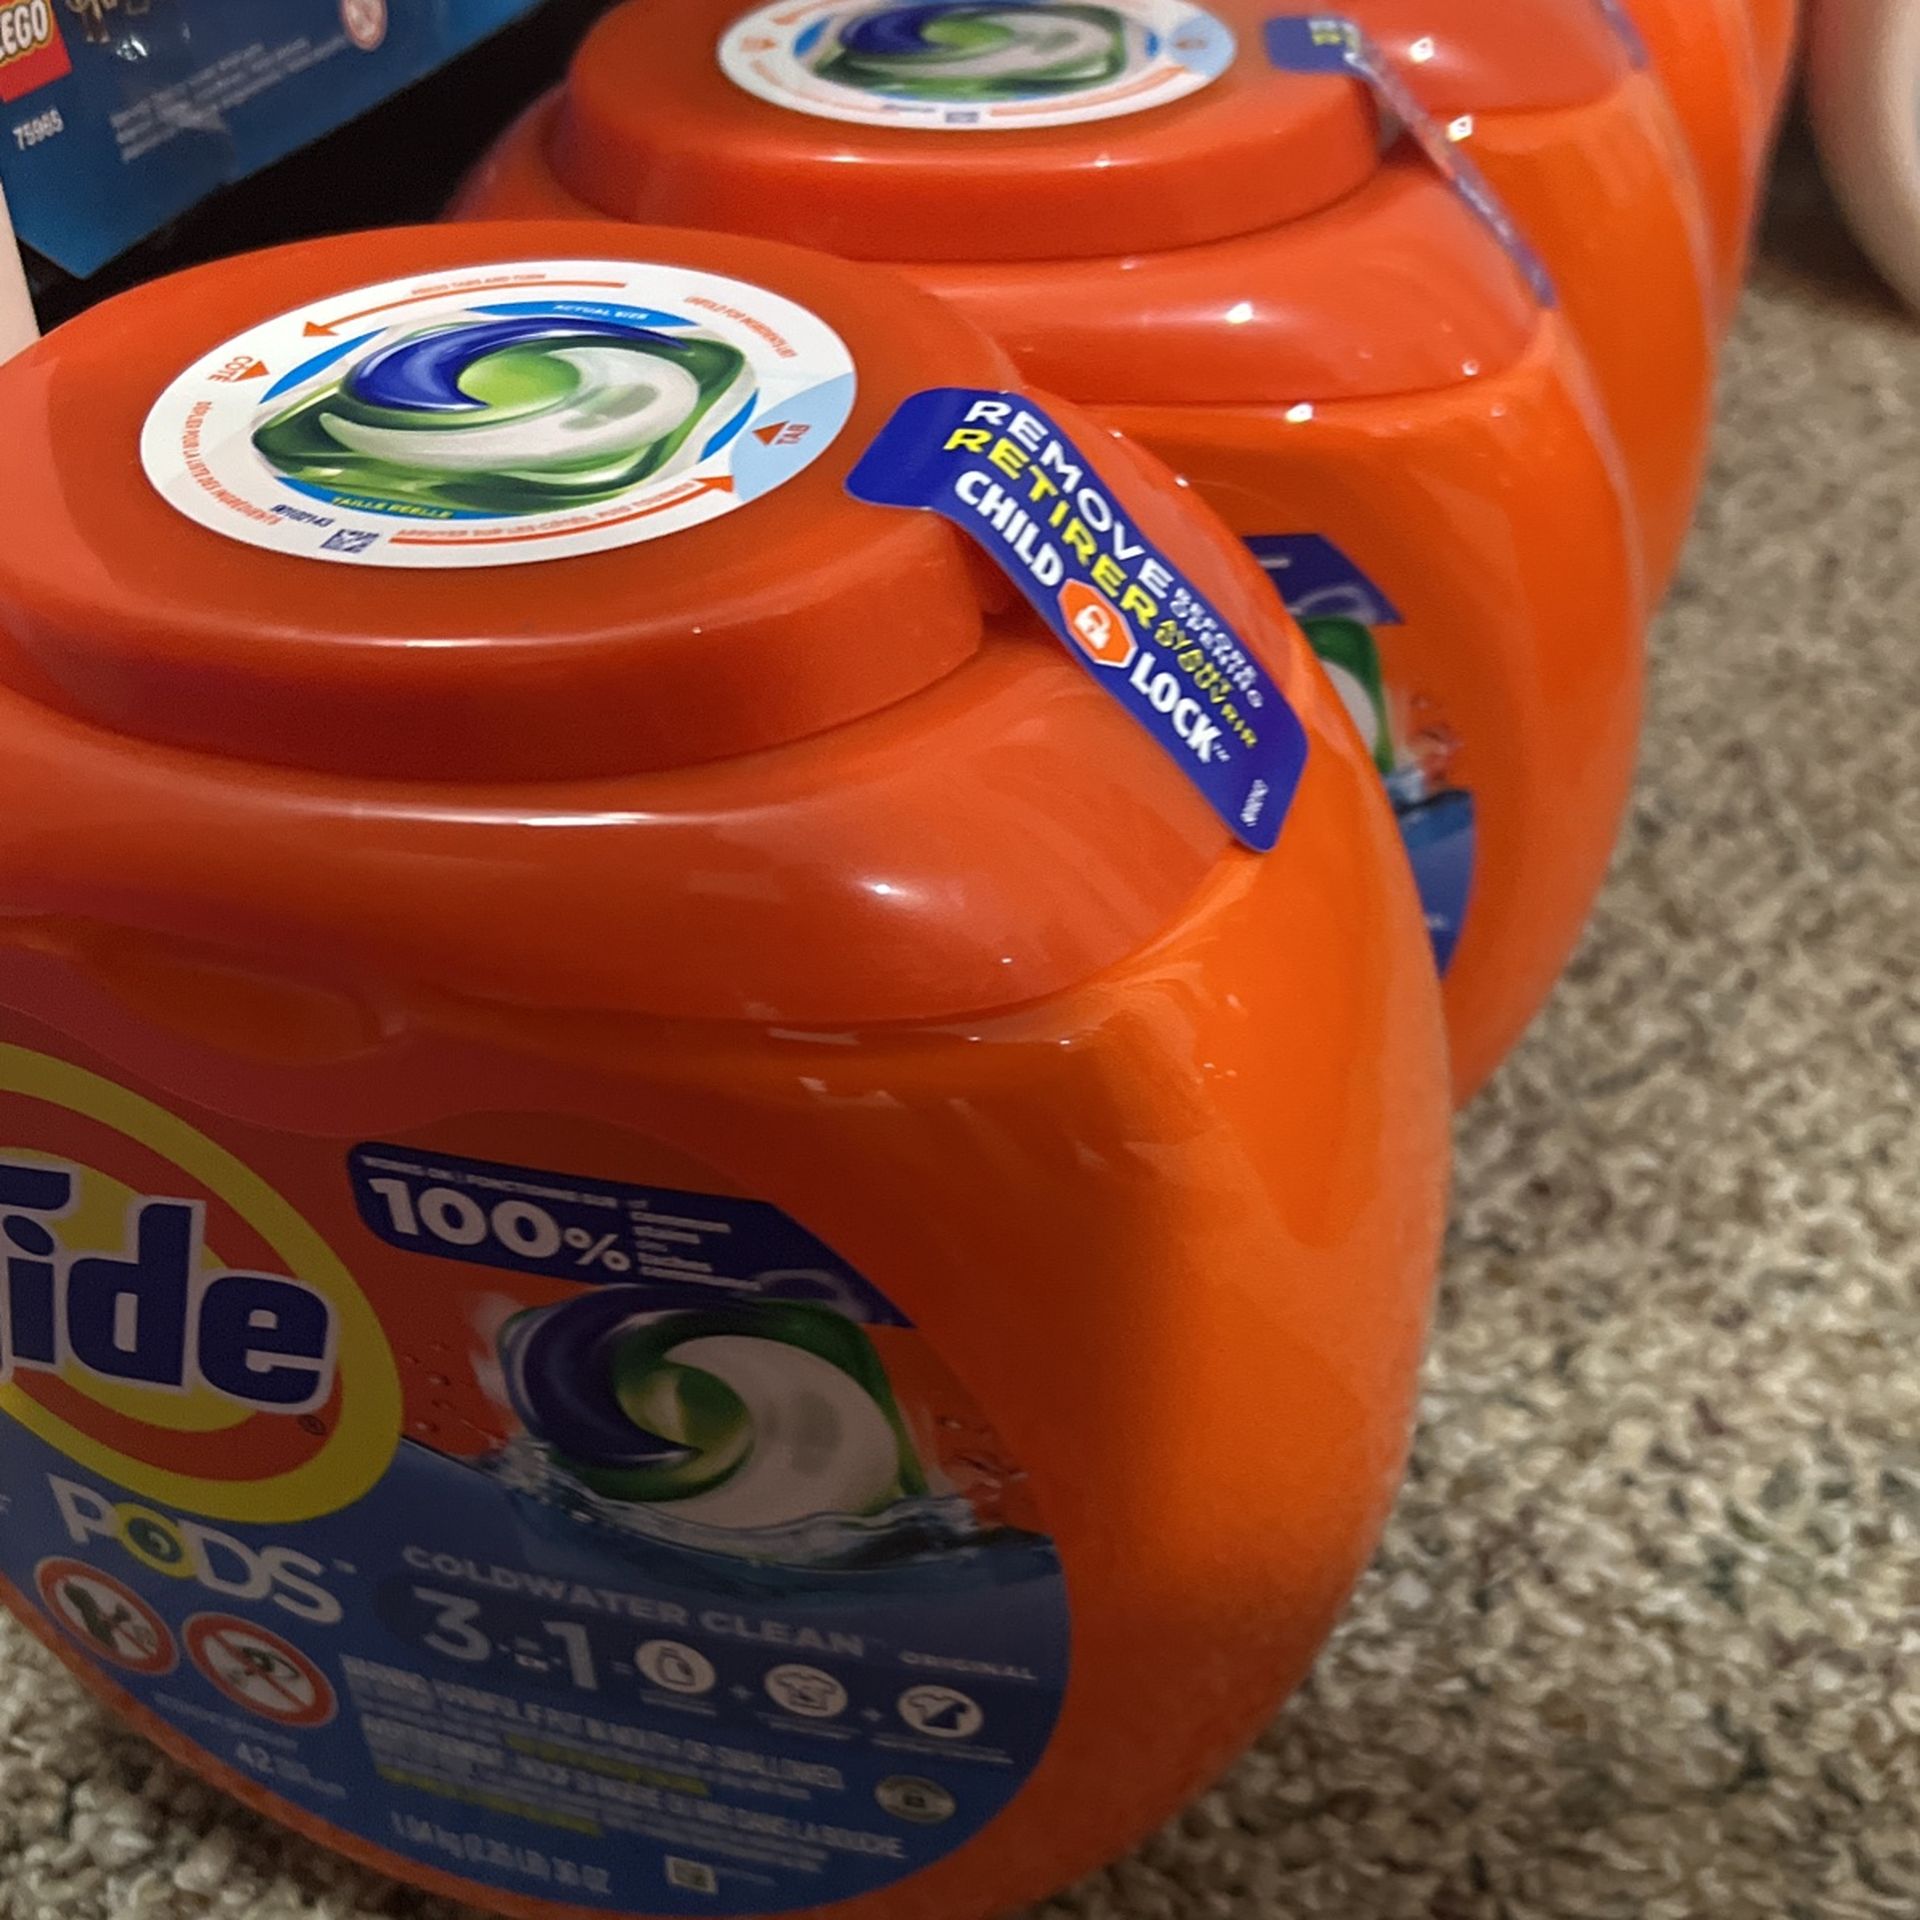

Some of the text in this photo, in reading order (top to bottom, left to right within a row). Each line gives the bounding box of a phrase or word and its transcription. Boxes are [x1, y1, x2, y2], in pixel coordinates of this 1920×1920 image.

[554, 303, 610, 318] ACTUAL
[773, 424, 812, 447] TAB
[943, 427, 1159, 630] RETIRER
[955, 470, 1064, 588] CHILD
[964, 400, 1174, 598] REMOVE
[367, 1177, 632, 1273] 100%
[47, 1472, 343, 1624] PODS
[402, 1545, 687, 1627] COLDWATER
[412, 1586, 490, 1662] 3
[544, 1620, 598, 1691] 1
